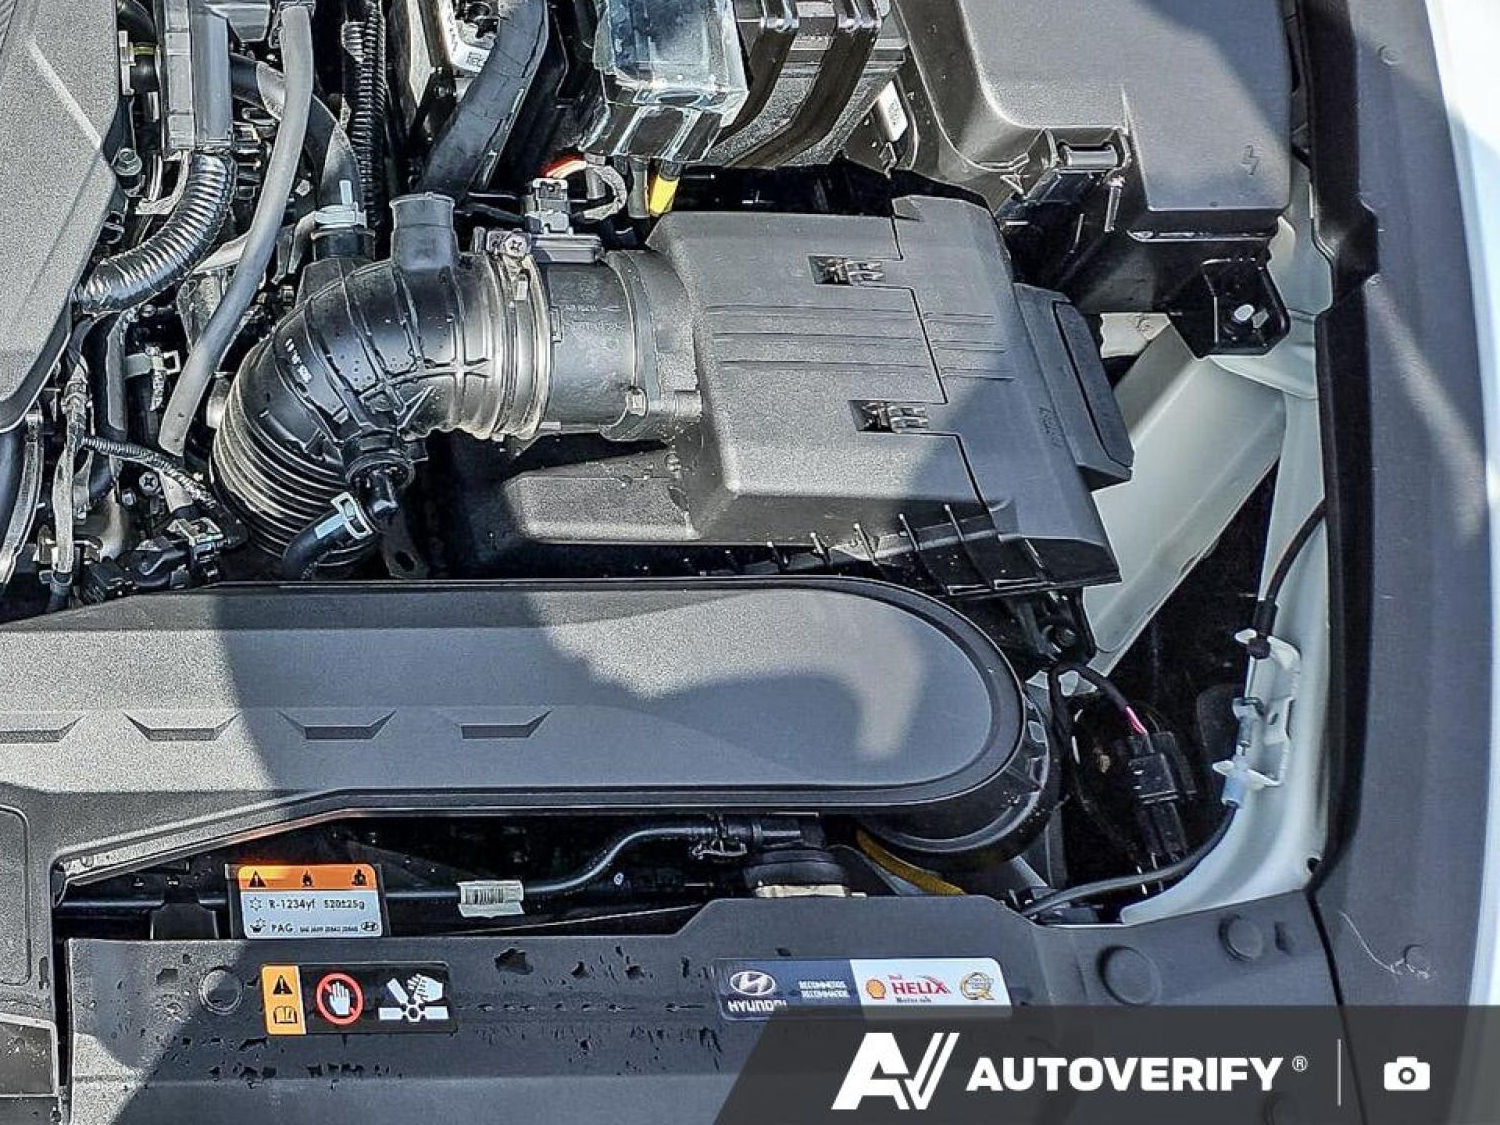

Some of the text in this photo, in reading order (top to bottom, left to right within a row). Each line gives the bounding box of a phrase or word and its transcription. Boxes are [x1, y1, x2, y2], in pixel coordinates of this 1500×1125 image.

[268, 898, 316, 912] R-1234yf
[271, 922, 293, 932] PAG
[891, 981, 950, 995] HELIX
